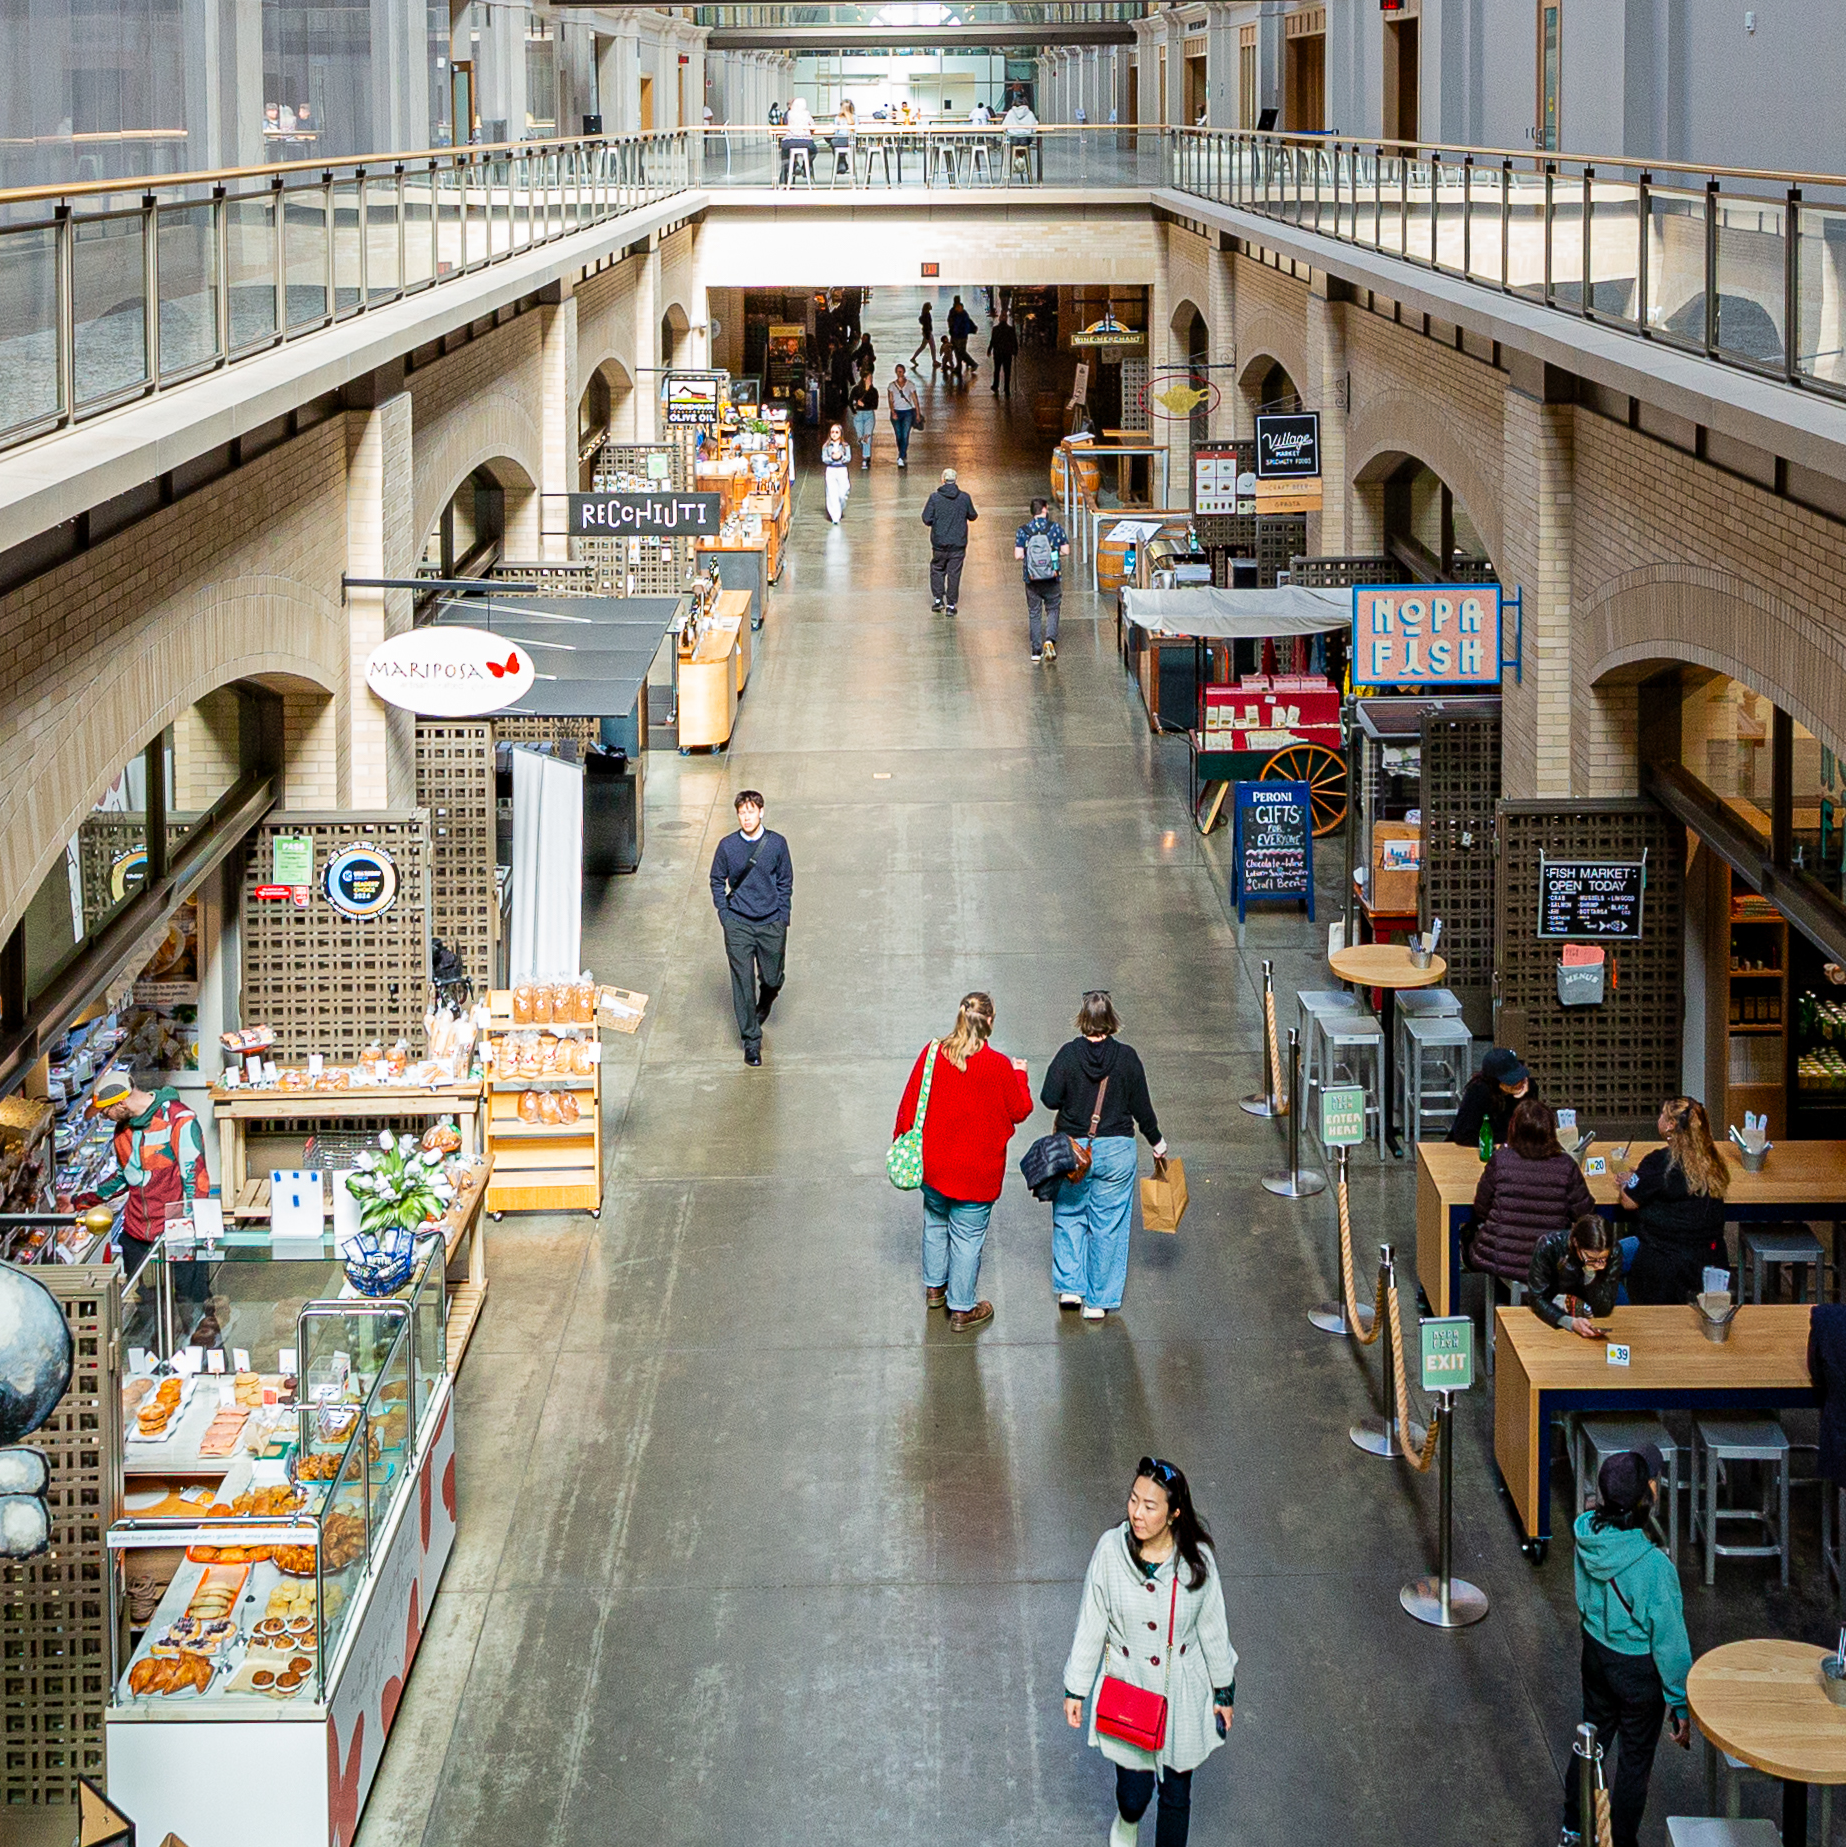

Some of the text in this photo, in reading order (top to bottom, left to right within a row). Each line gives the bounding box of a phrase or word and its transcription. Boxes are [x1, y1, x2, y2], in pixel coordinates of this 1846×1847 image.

[669, 414, 716, 422] OLIVE OIL
[1262, 432, 1313, 451] Village
[1295, 457, 1311, 465] FOODS
[582, 498, 707, 529] RECCHIUTI
[1372, 597, 1484, 637] NOPA
[1372, 639, 1484, 676] FISH
[370, 661, 484, 679] MARIPOSA
[1252, 792, 1292, 802] PERONI
[1256, 805, 1300, 824] GIFTS
[1258, 834, 1300, 846] EVERYONE
[282, 842, 305, 851] PASS
[1252, 879, 1273, 890] Craft
[1549, 880, 1627, 891] OPEN TODAY
[1565, 973, 1599, 985] MENUS
[1326, 1113, 1361, 1124] ENTER
[1328, 1125, 1358, 1136] HERE
[1594, 1159, 1604, 1170] 20
[1616, 1347, 1628, 1360] 39
[1426, 1353, 1466, 1372] EXIT
